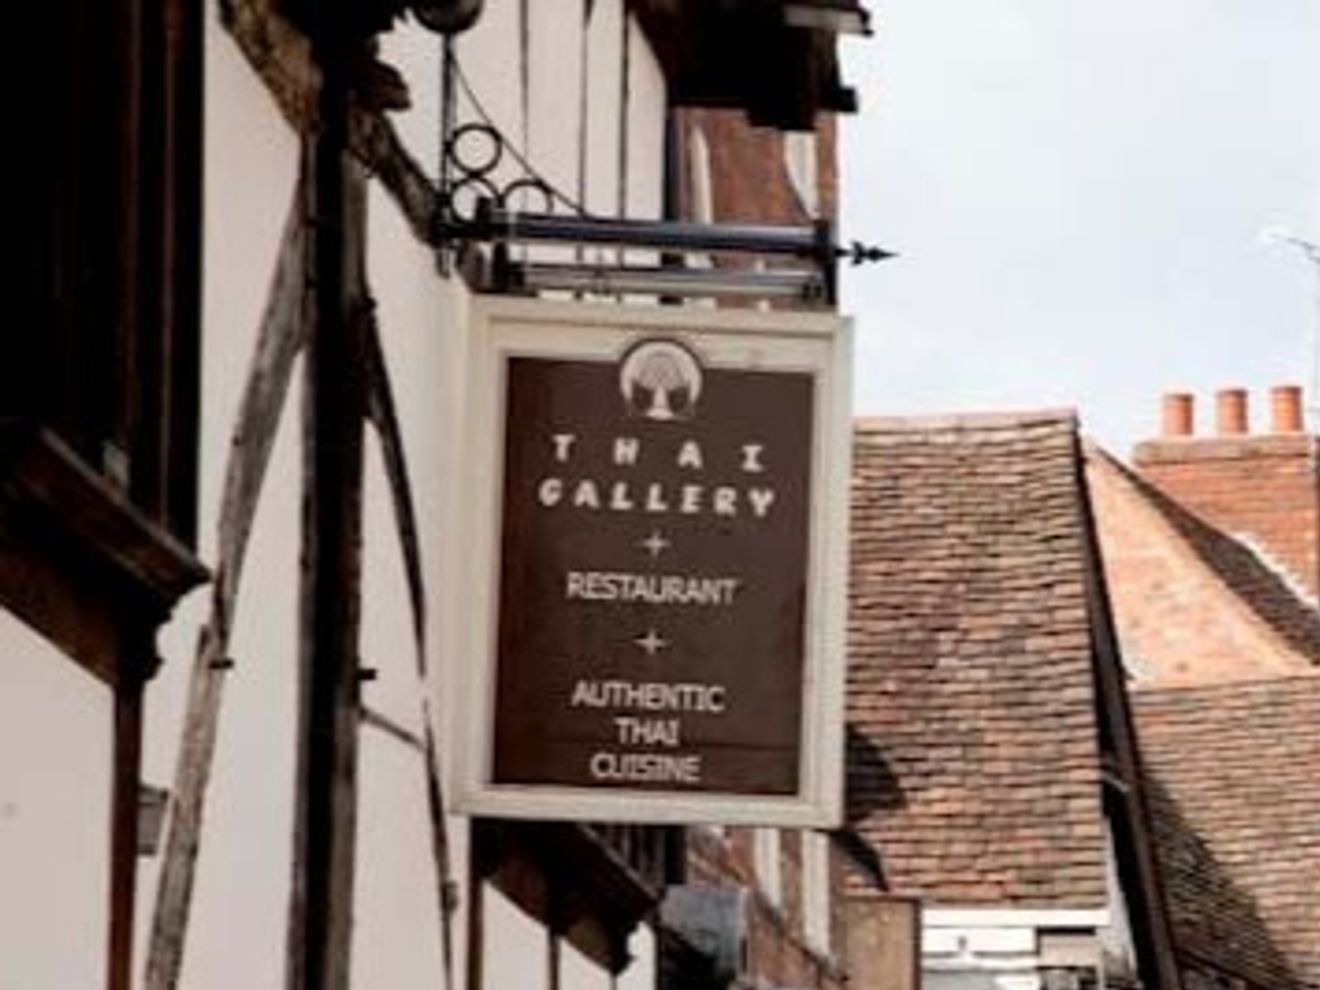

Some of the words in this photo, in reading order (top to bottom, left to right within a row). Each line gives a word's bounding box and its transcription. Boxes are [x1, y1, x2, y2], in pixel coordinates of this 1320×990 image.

[539, 478, 775, 517] GALLERY
[566, 571, 738, 604] RESTAURANT
[571, 679, 726, 713] AUTHENTIC
[614, 716, 681, 746] THAI
[589, 753, 702, 782] CUISINE
